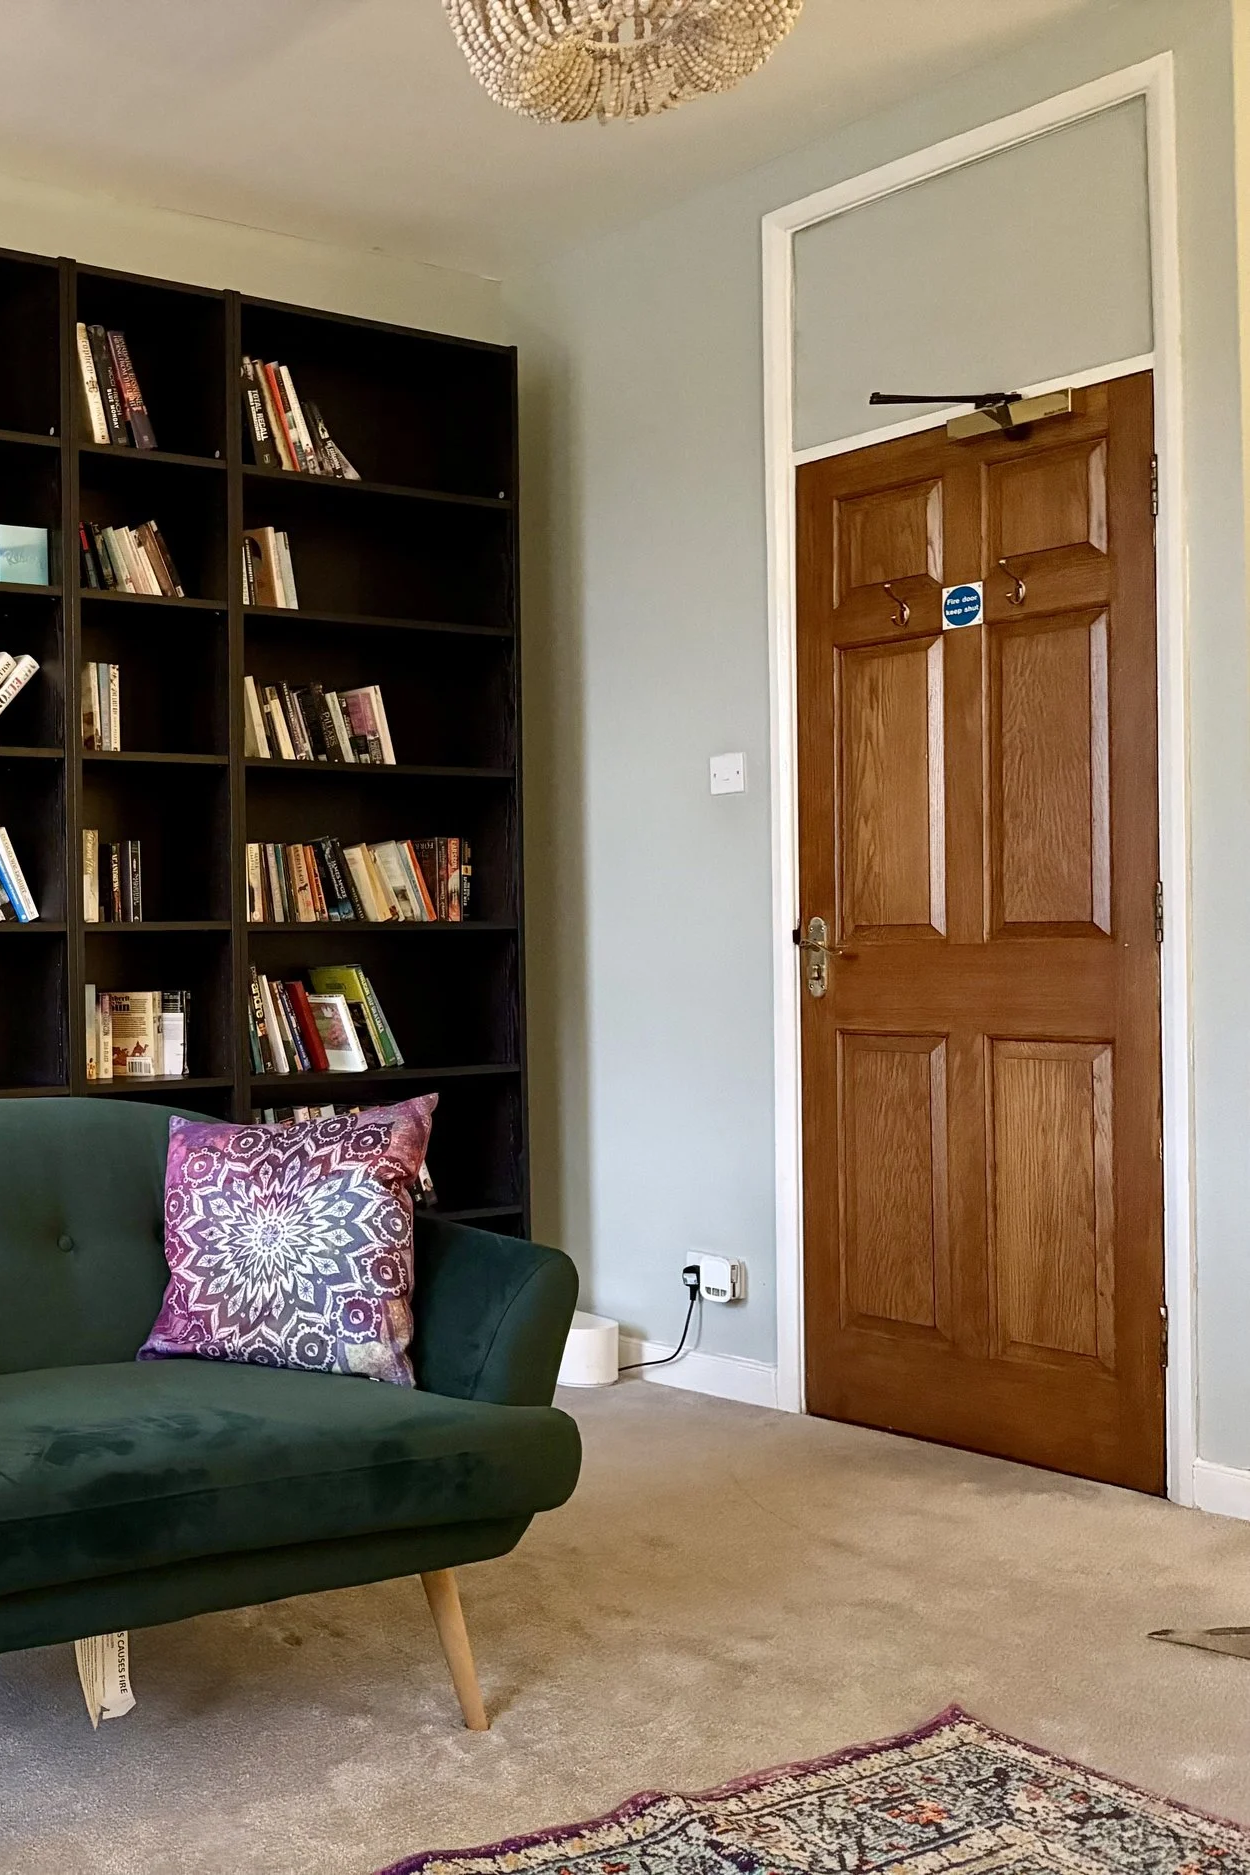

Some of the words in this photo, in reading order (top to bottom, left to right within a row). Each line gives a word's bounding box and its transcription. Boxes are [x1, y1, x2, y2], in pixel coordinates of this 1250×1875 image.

[129, 372, 143, 406] ERSKINE
[109, 404, 119, 428] MONDAY
[250, 389, 261, 411] TOTAL
[256, 411, 269, 441] RECALL
[945, 607, 962, 616] keep
[963, 604, 980, 613] shut
[947, 597, 960, 606] Fire
[961, 594, 978, 603] door
[322, 710, 338, 747] PILLARS
[330, 859, 341, 879] JAMES
[250, 982, 265, 1019] andre
[117, 1640, 125, 1673] CAUSES
[118, 1675, 128, 1694] FIRE
